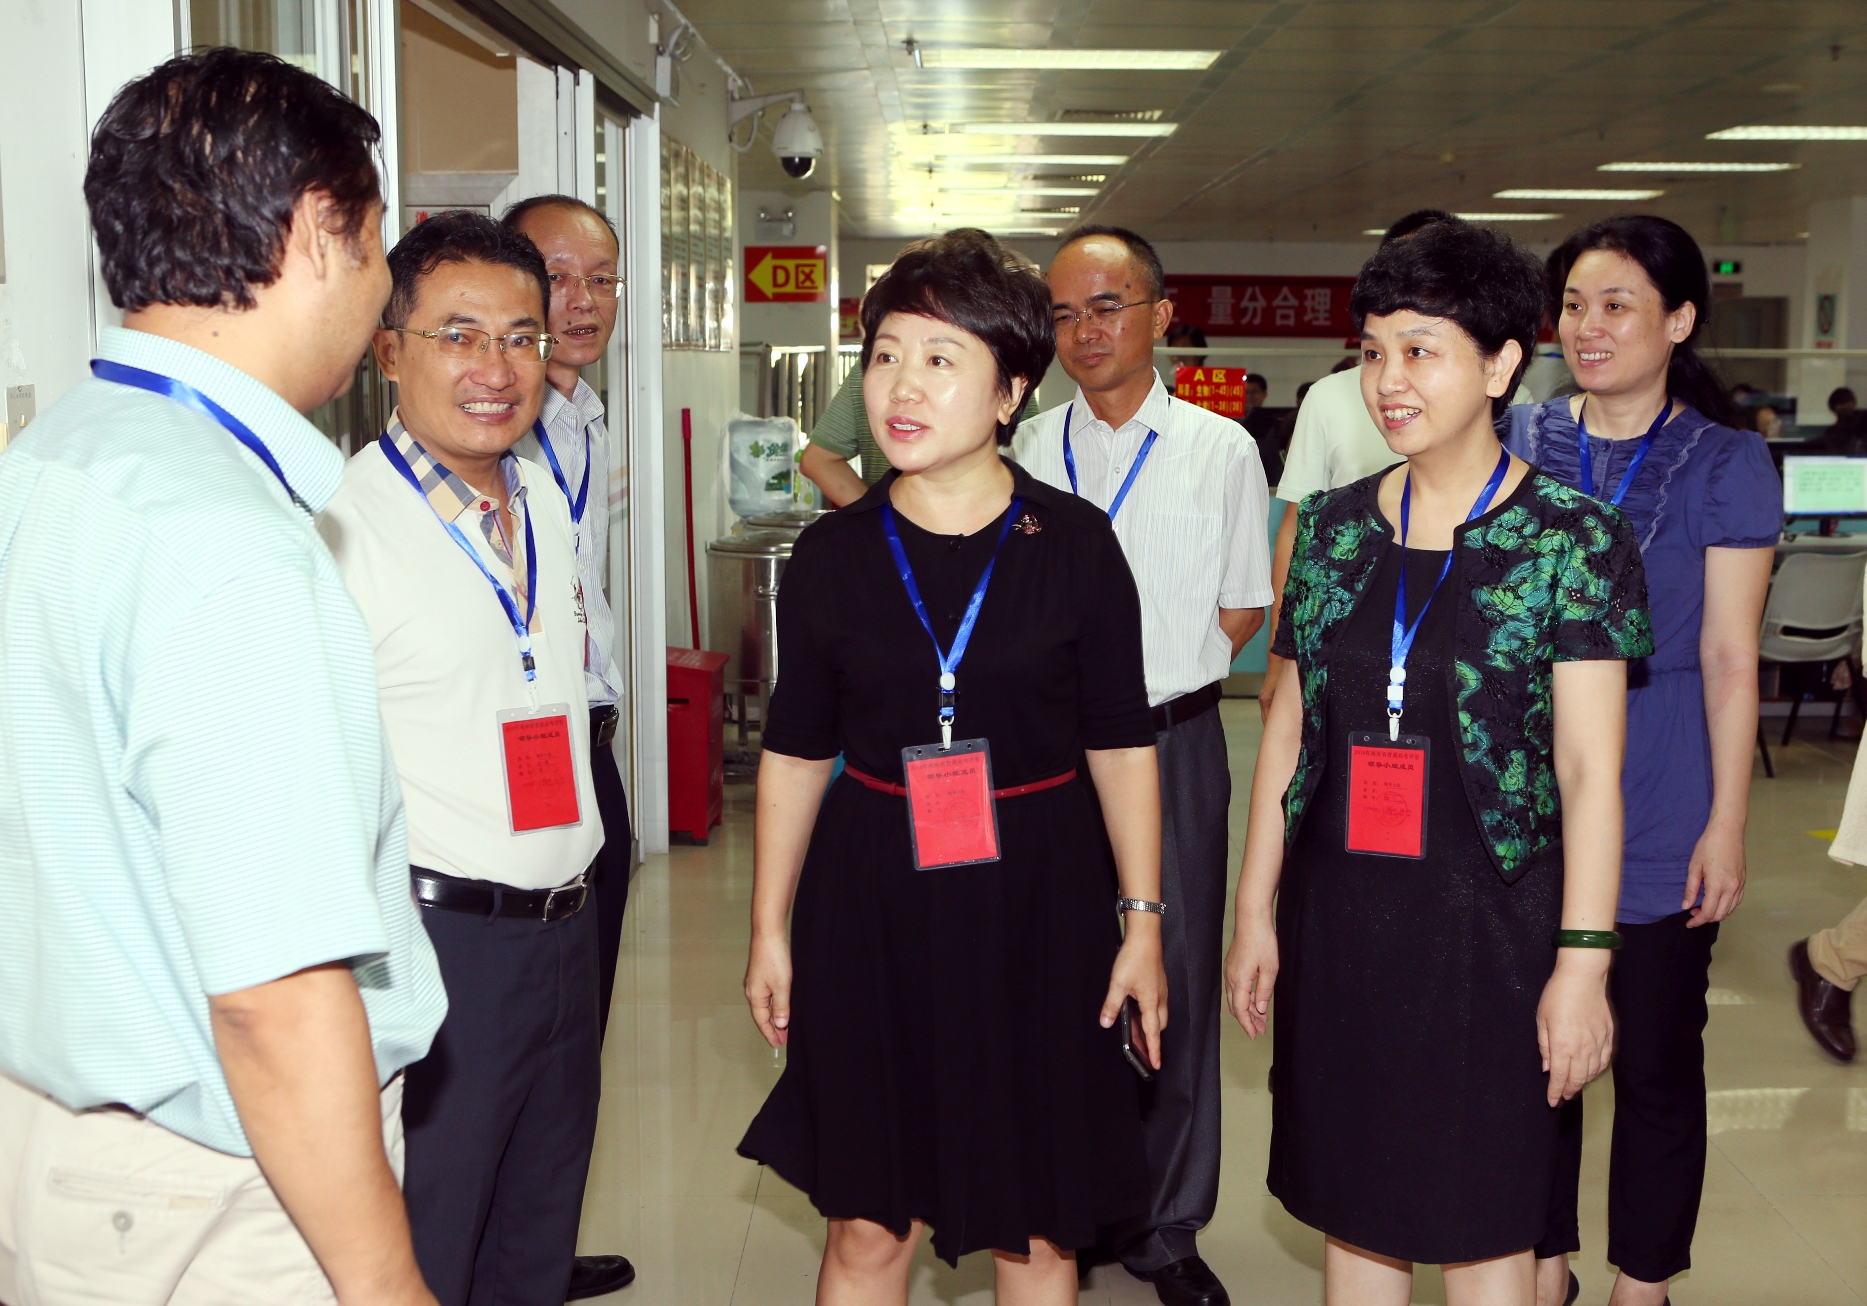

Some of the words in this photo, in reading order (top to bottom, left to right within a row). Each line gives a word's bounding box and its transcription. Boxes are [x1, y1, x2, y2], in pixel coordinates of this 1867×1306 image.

[772, 263, 818, 290] D区
[1207, 285, 1332, 326] 量分合理
[1367, 761, 1415, 771] 领导小组成员
